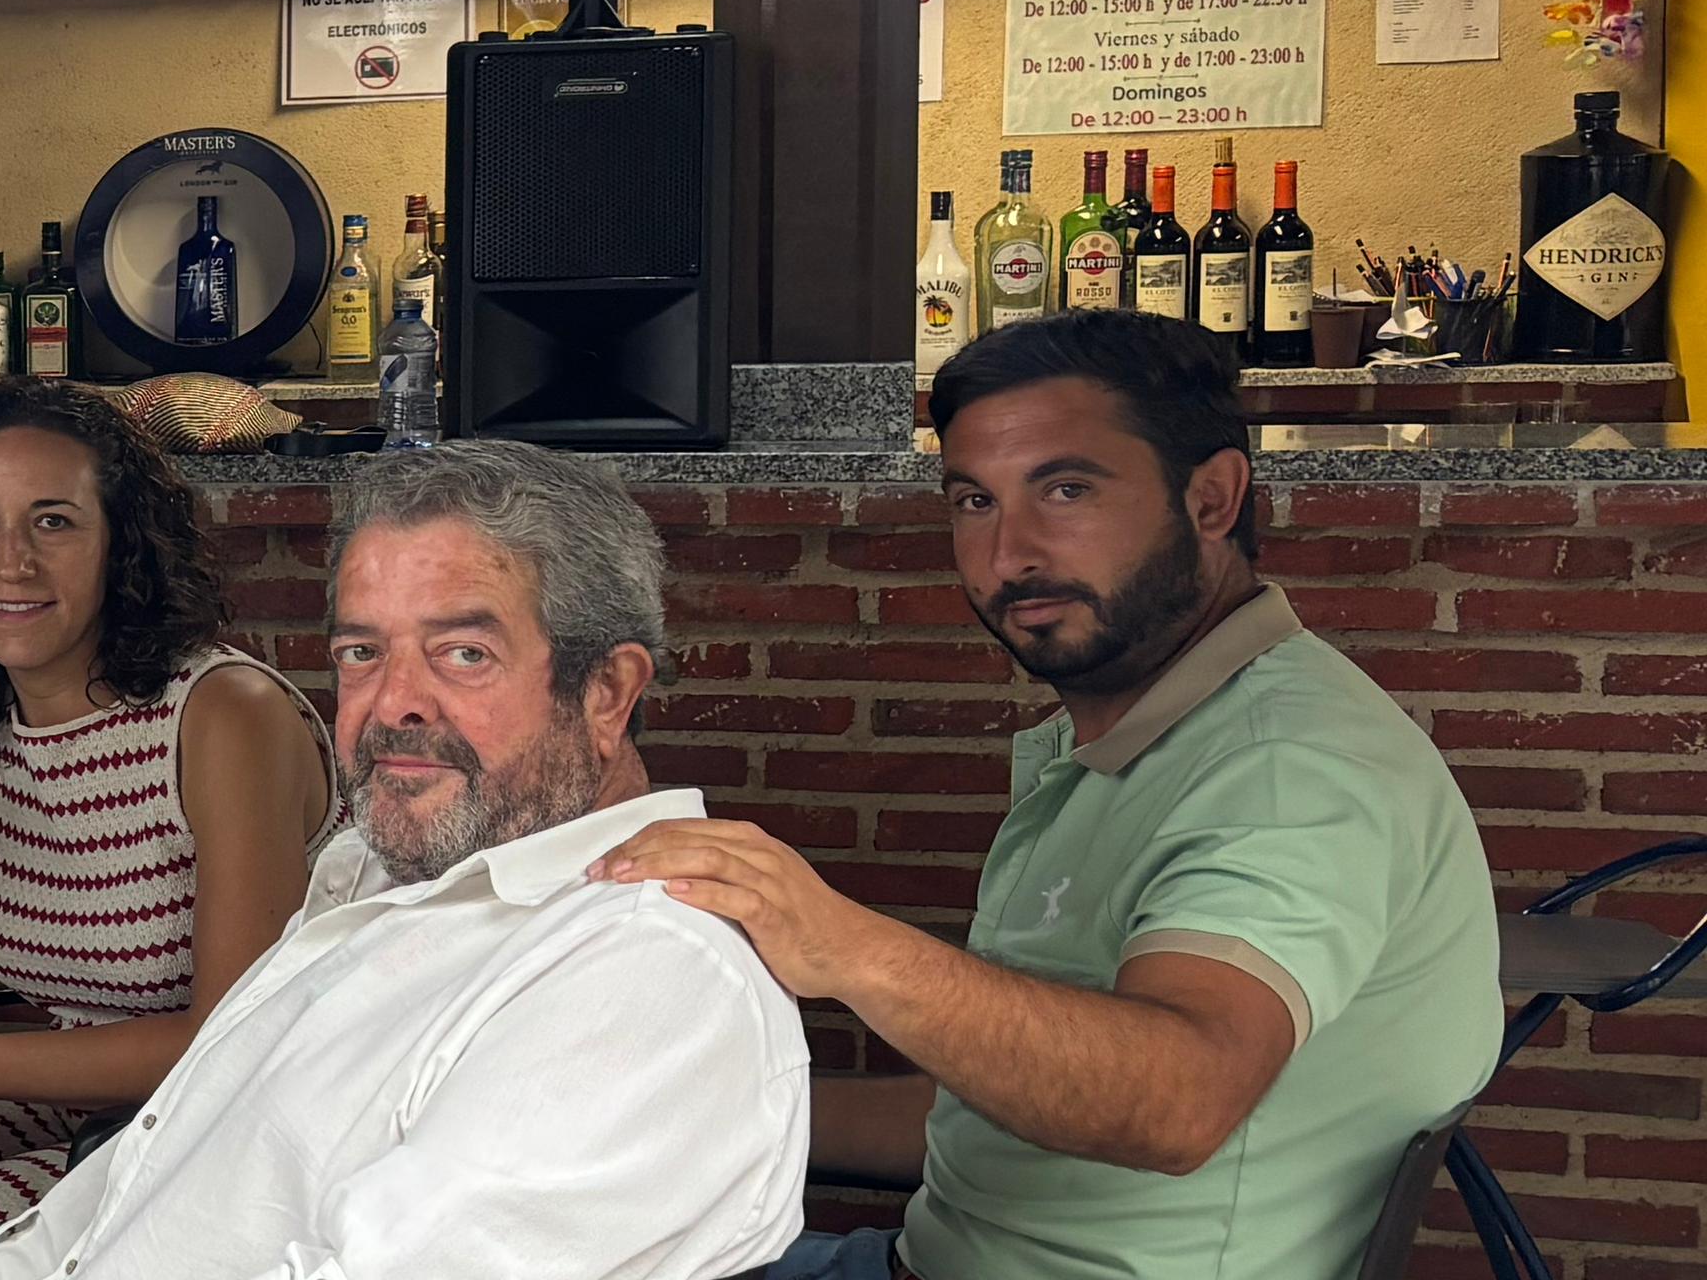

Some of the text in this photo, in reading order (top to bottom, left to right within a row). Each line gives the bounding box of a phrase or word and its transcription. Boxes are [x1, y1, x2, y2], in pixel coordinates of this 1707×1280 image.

[1025, 2, 1044, 17] De
[1050, 0, 1087, 15] 12:00
[1164, 0, 1173, 15] y
[327, 21, 427, 38] ELECTRÓNICOS
[1095, 27, 1240, 48] Viernes y sábado
[1023, 58, 1041, 74] De
[1047, 56, 1084, 72] 12:00
[1101, 54, 1138, 70] 15:00
[1143, 53, 1152, 69] h
[1161, 56, 1170, 72] y
[1174, 51, 1191, 68] de
[1197, 50, 1235, 66] 17:00
[1250, 47, 1290, 65] 23:00
[1296, 46, 1304, 62] h
[1071, 112, 1095, 127] De
[1102, 110, 1153, 126] 12:00
[1178, 107, 1230, 123] 23:00
[1236, 106, 1247, 121] h
[164, 135, 236, 152] MASTER'S
[1068, 257, 1120, 269] MARTINI
[1539, 245, 1664, 265] HENDRICK'S
[995, 263, 1042, 273] MARTINI
[1591, 272, 1628, 283] GIN
[210, 257, 224, 324] MASTER'S
[917, 279, 964, 298] MALIBU
[1076, 287, 1112, 297] ROSSO
